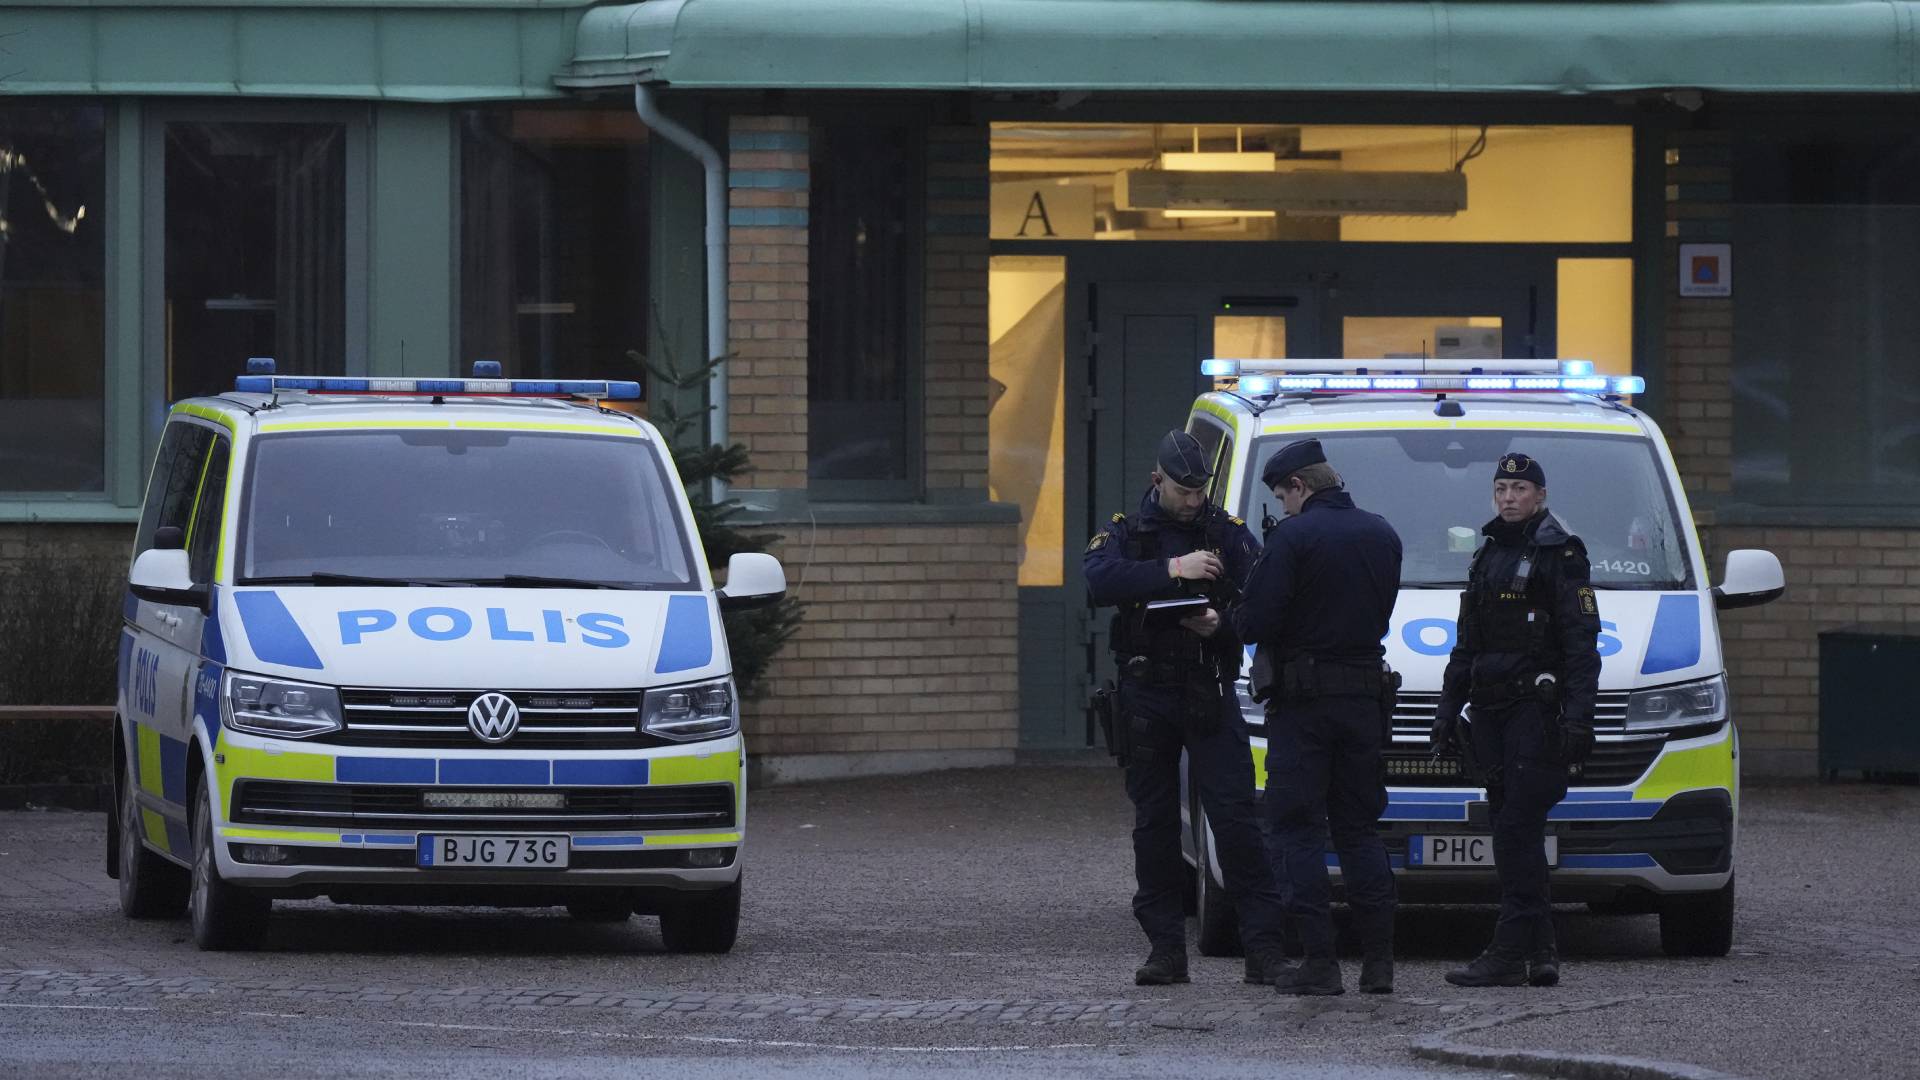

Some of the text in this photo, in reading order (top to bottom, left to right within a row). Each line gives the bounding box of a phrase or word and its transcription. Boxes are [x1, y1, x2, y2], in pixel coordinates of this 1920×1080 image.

[1015, 190, 1058, 237] A
[1590, 559, 1650, 576] -1420
[337, 606, 631, 648] POLIS
[134, 647, 160, 718] POLIS
[443, 838, 557, 864] BJG 73G
[1433, 838, 1484, 862] PHC
